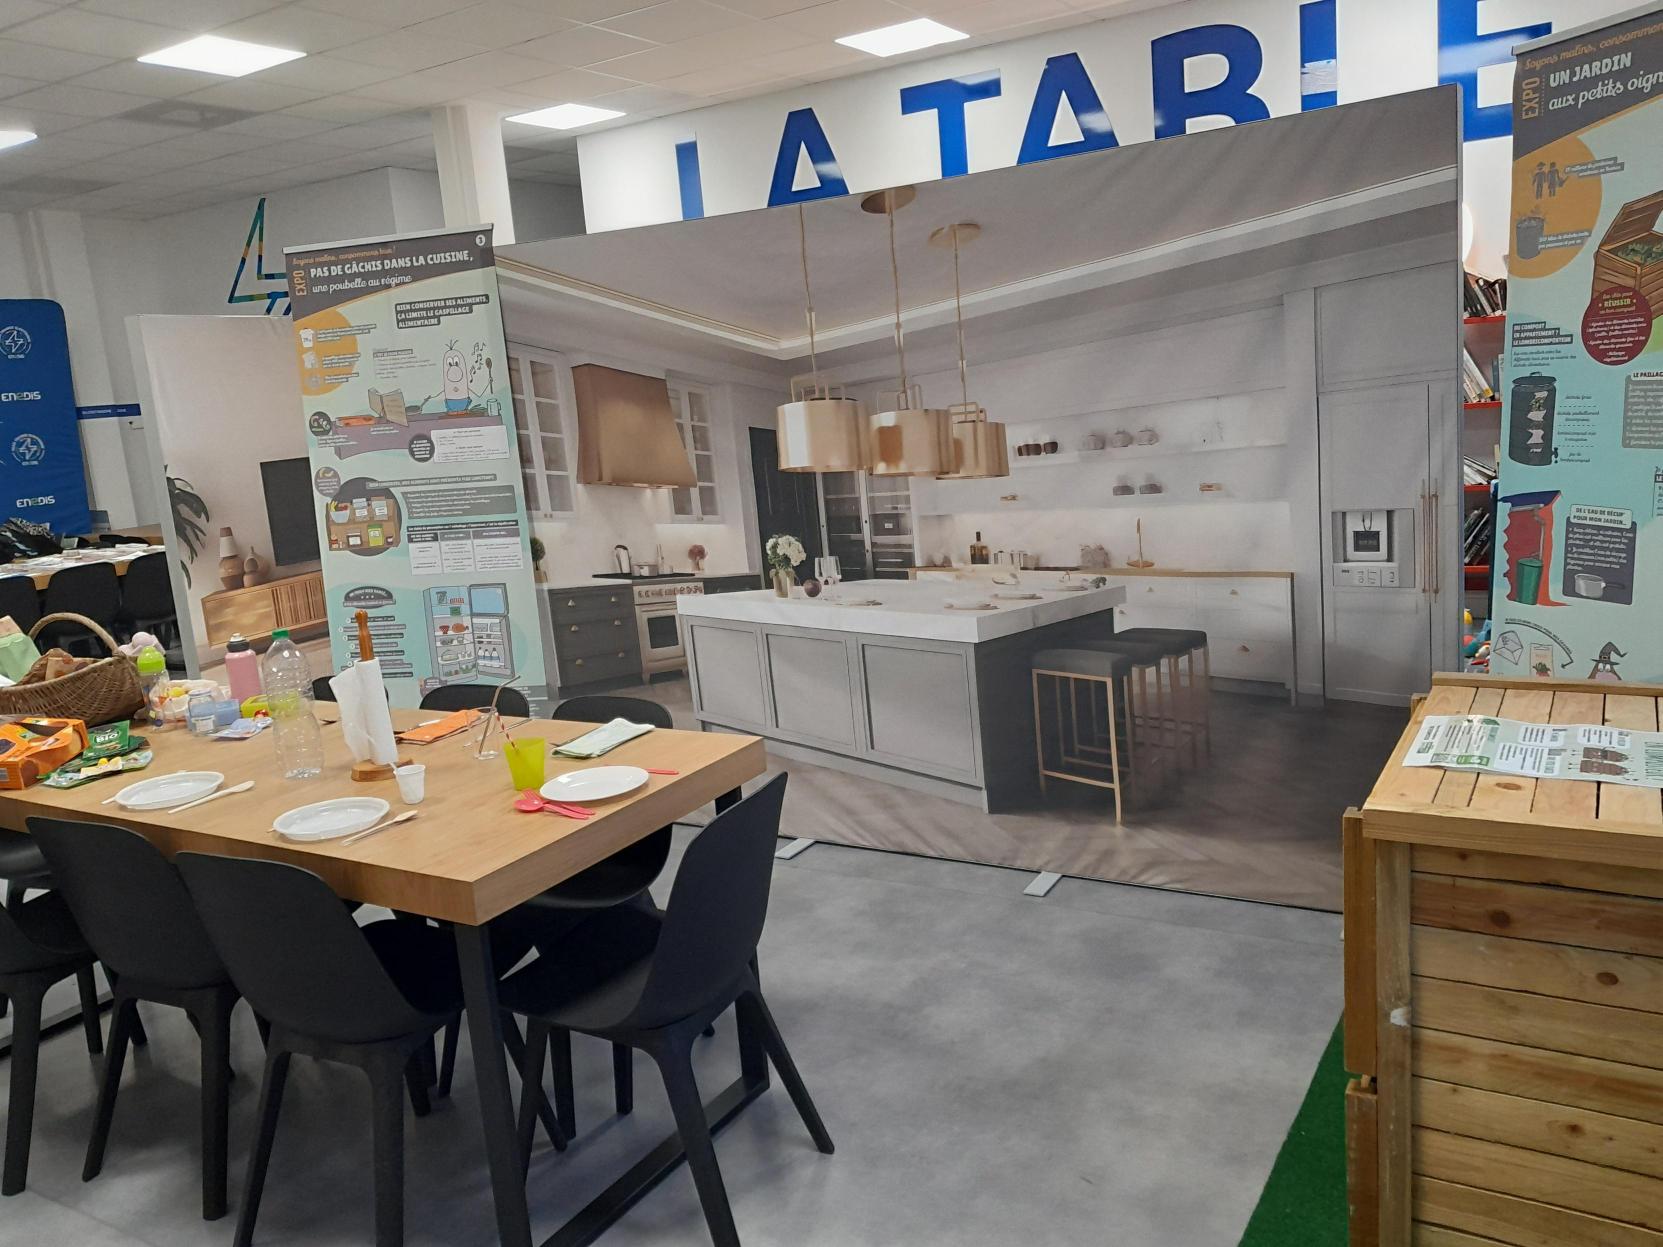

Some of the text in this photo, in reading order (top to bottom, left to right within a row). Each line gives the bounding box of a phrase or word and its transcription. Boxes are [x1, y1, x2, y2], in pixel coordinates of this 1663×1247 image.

[1524, 55, 1558, 70] Soyons
[1560, 45, 1596, 61] malins,
[1550, 52, 1632, 87] UN JARDIN
[1522, 77, 1540, 120] EXPO
[1549, 93, 1576, 110] aux
[1578, 79, 1624, 109] petits
[310, 250, 474, 278] PAS DE GÂCHIS DANS LA CUISINE,
[293, 270, 307, 296] EXPO
[312, 284, 328, 293] une
[330, 278, 367, 295] poubelle
[381, 274, 413, 288] régime
[398, 312, 405, 320] ÇA
[406, 310, 427, 319] LIMITE
[434, 307, 470, 316] GASPILLAGE
[411, 300, 444, 310] CONSERVER
[446, 298, 456, 306] SES
[398, 318, 438, 328] ALIMENTAIRE
[1520, 330, 1554, 338] APPARTEMENT
[96, 731, 118, 743] BIO
